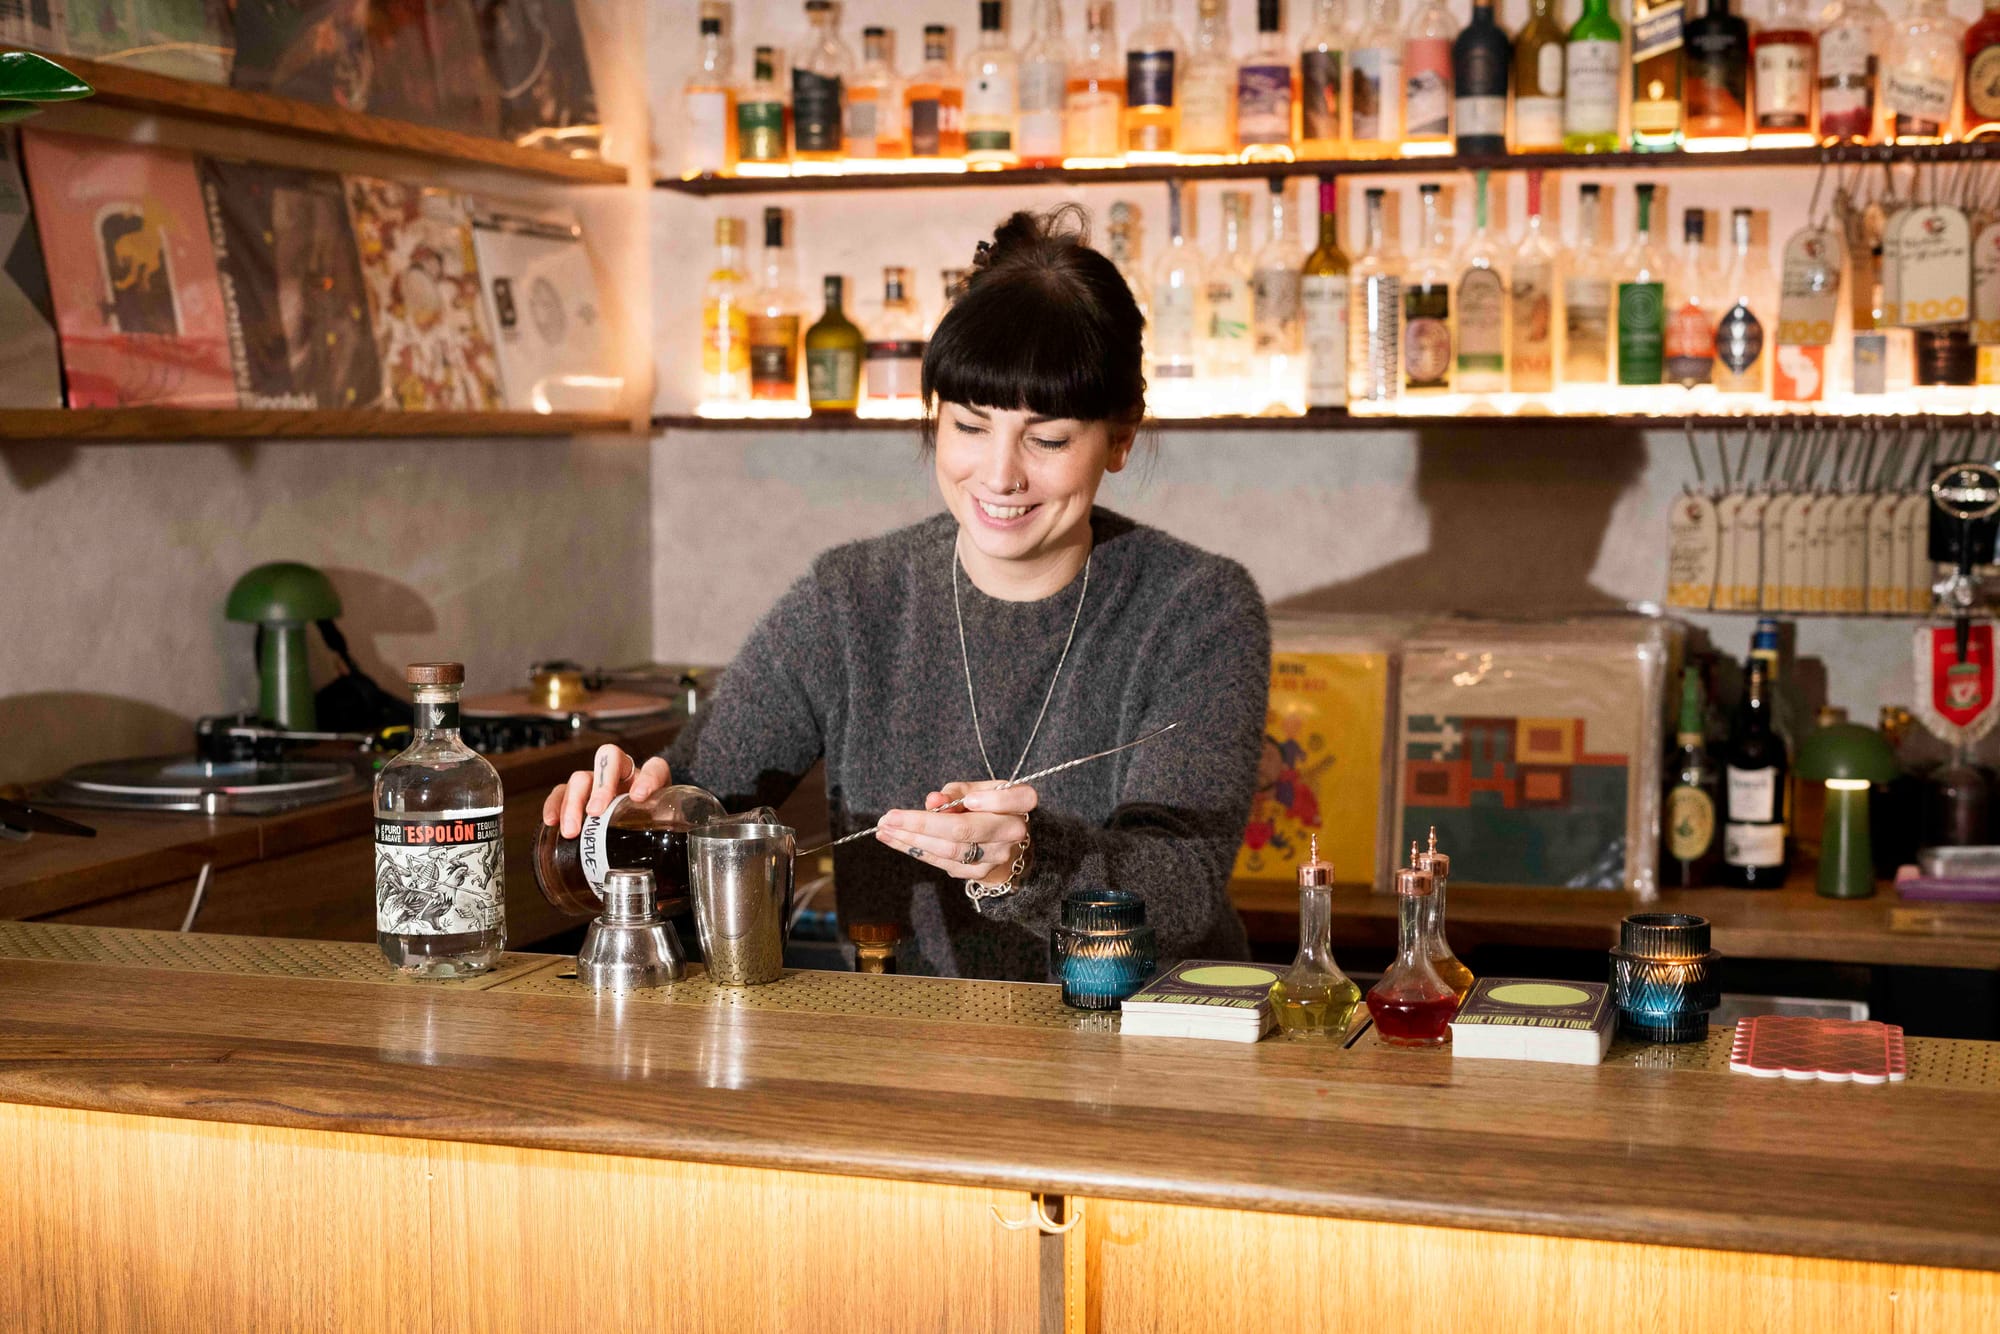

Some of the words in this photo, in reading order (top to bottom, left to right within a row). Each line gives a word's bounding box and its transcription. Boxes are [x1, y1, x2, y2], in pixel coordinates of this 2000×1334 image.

[384, 824, 401, 835] PURO
[477, 820, 498, 831] TEQUILA
[384, 834, 402, 843] AGAVE
[477, 828, 498, 840] BLANCO
